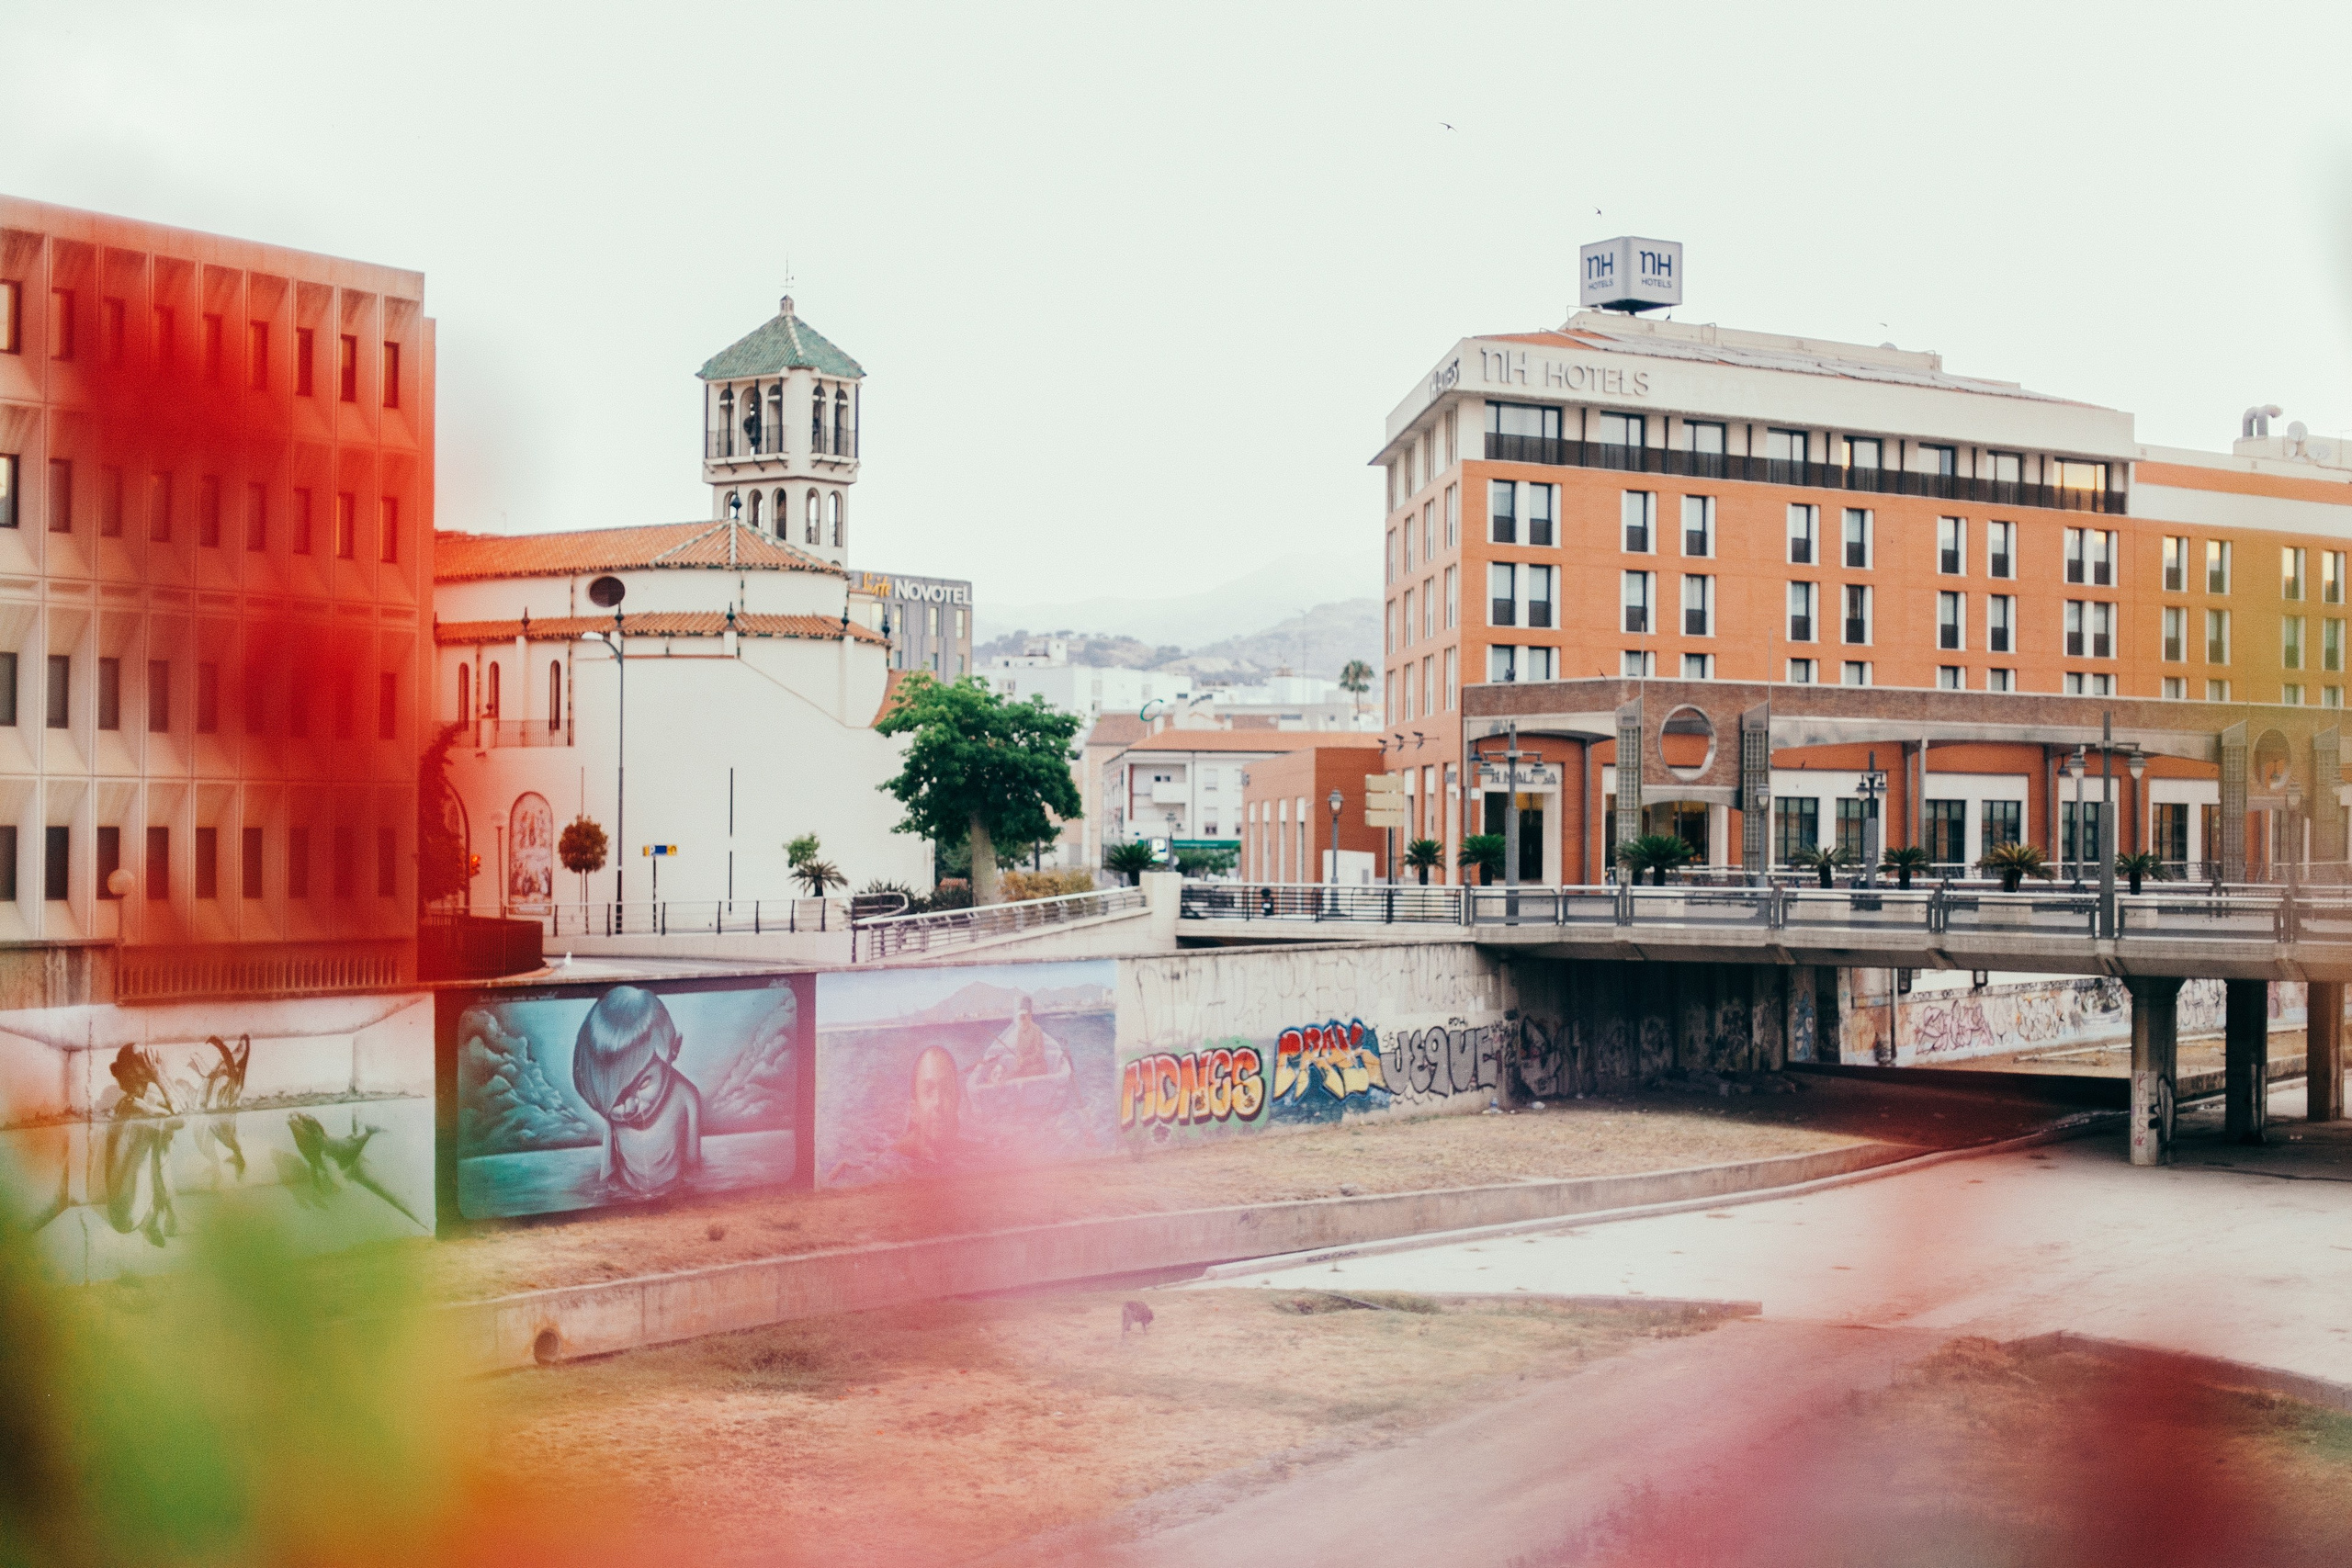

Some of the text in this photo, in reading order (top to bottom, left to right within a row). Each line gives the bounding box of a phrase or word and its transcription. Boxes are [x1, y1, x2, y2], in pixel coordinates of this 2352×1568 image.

[1589, 277, 1614, 290] HOTELS
[1641, 277, 1672, 288] HOTELS
[1544, 361, 1650, 397] HOTELS
[894, 578, 972, 606] NOVOTEL
